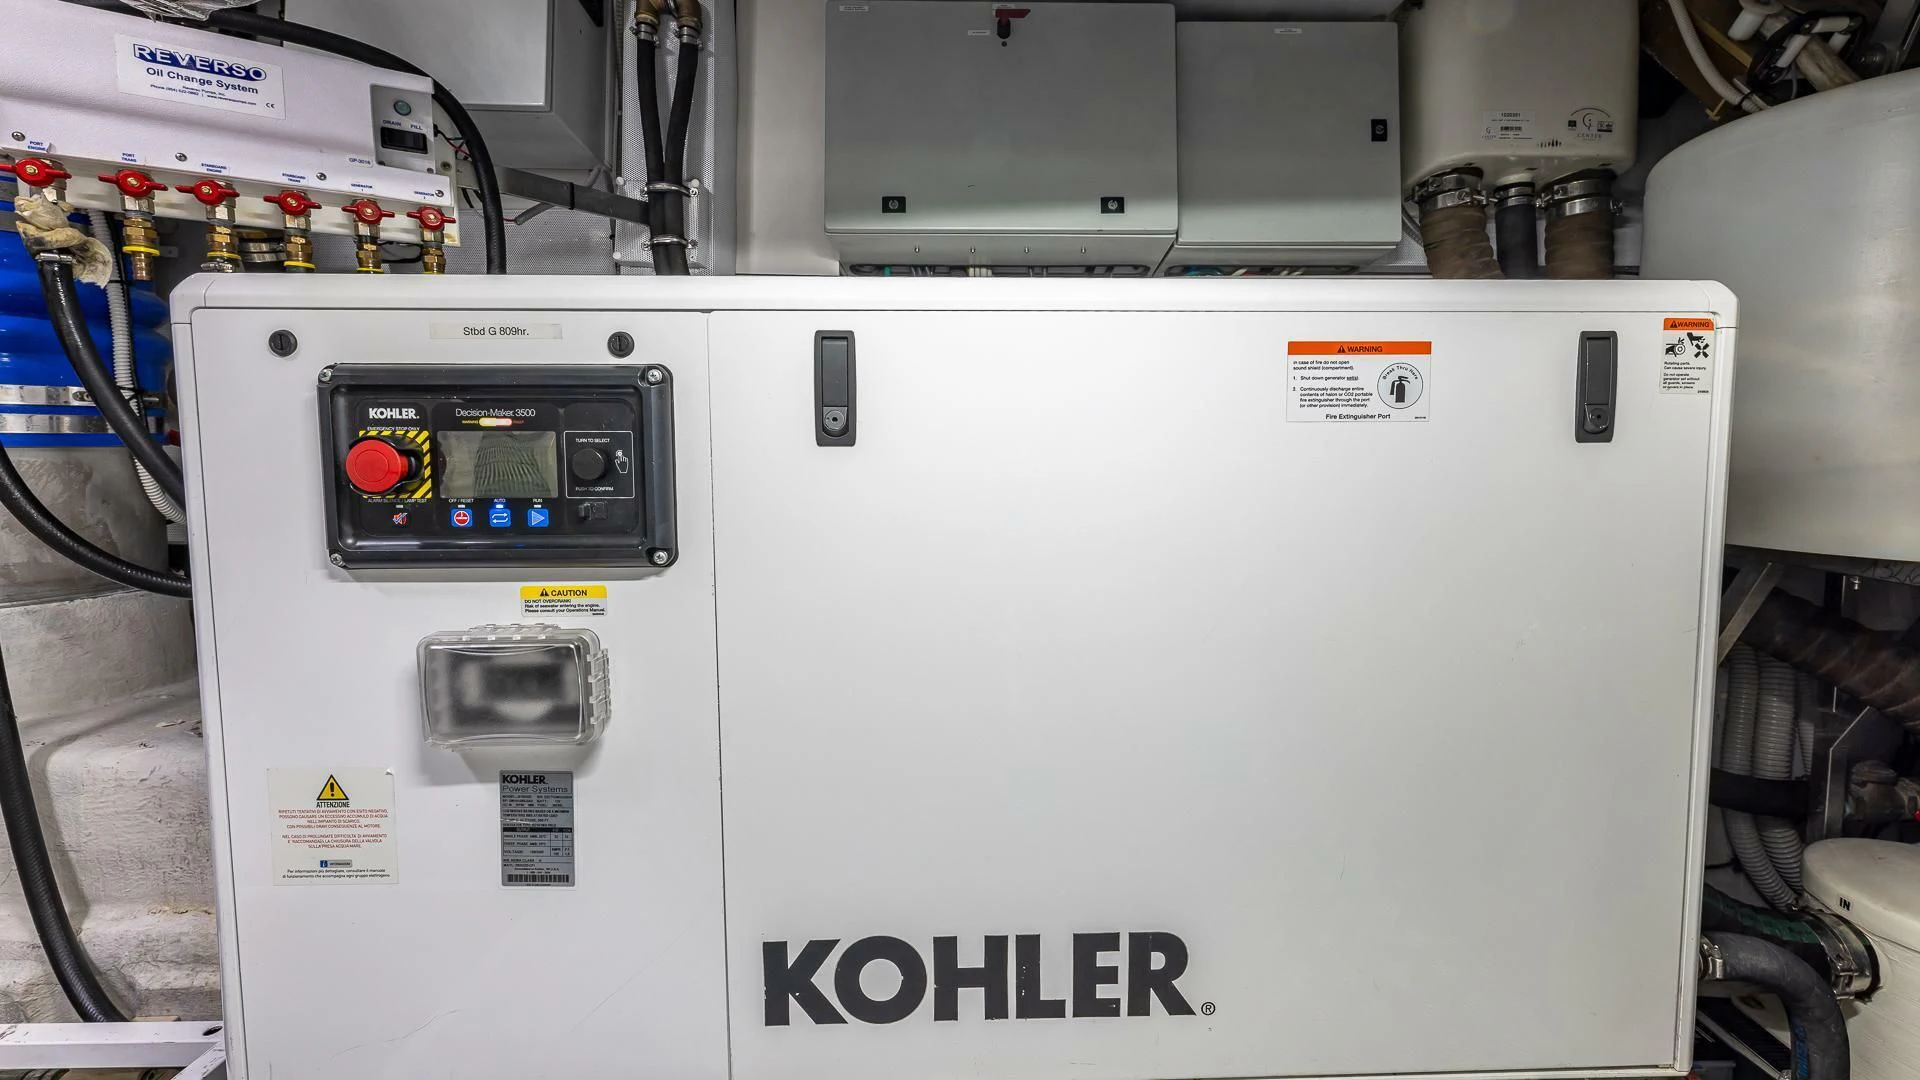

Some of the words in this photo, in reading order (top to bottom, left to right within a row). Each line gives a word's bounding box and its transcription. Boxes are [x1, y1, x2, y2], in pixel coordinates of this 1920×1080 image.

[133, 44, 266, 81] REVERSO
[146, 67, 164, 78] Oil
[167, 70, 212, 86] Change
[216, 79, 258, 94] System
[463, 326, 486, 336] Stbd
[488, 327, 496, 335] G
[499, 327, 529, 336] 809hr.
[515, 408, 536, 417] 3500
[531, 785, 568, 793] Systems
[1840, 896, 1850, 911] IN
